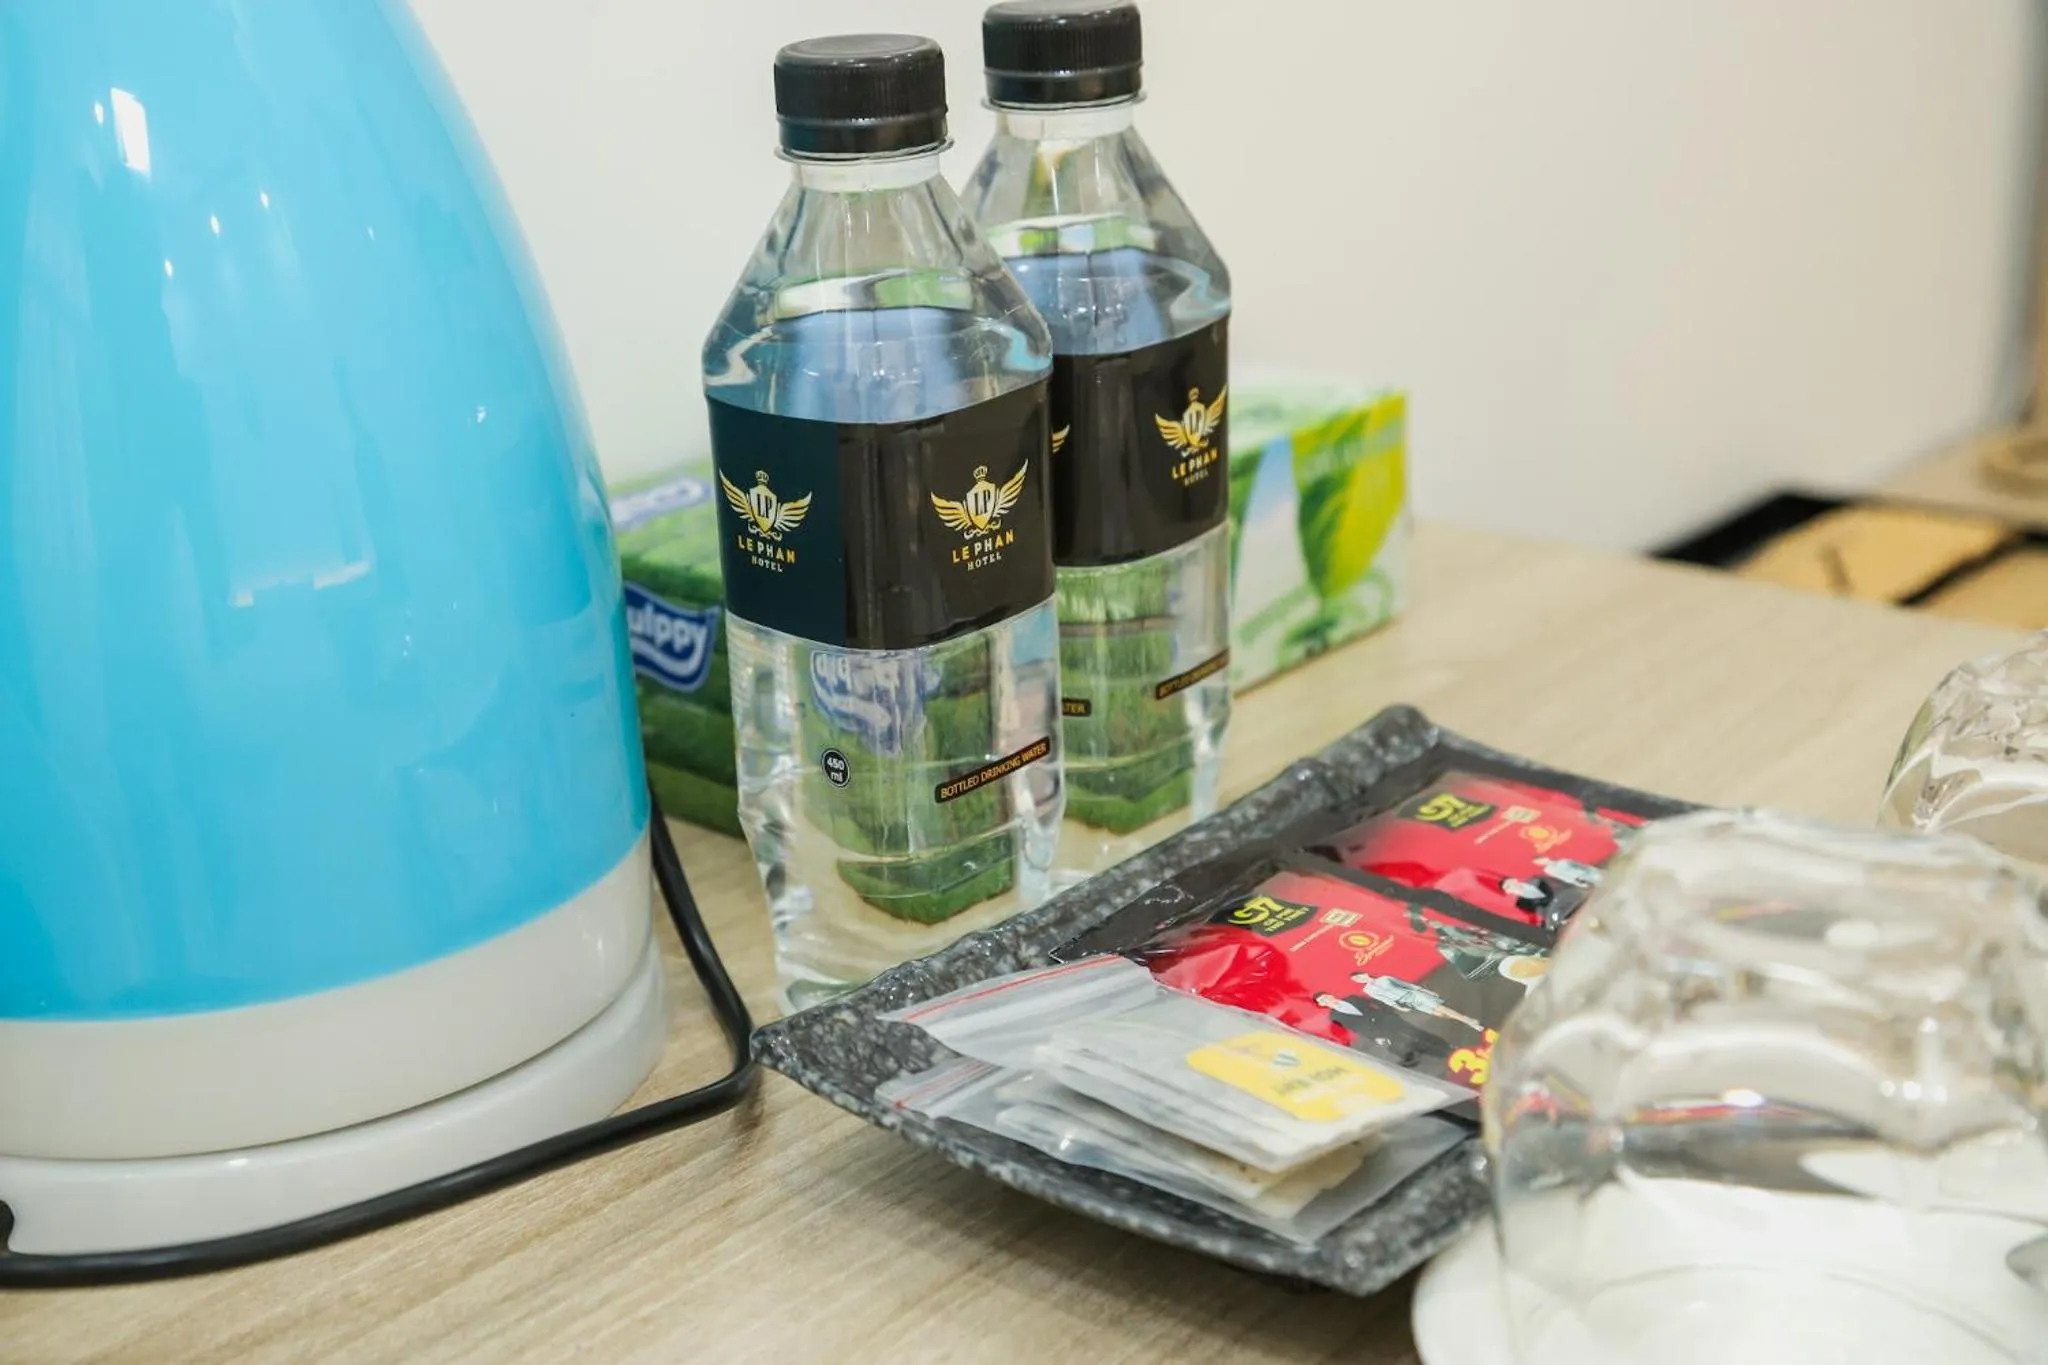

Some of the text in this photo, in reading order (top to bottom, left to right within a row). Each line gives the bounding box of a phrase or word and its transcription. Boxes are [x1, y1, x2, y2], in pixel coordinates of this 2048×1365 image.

[737, 534, 796, 564] LE PHAN
[952, 528, 1014, 564] LE PHAN
[751, 555, 784, 573] HOTEL
[967, 551, 1002, 572] HOTEL
[627, 601, 708, 662] ulppy
[826, 756, 845, 771] 450
[830, 770, 843, 782] ml
[940, 742, 1047, 799] BOTTLED DRINKING WATER
